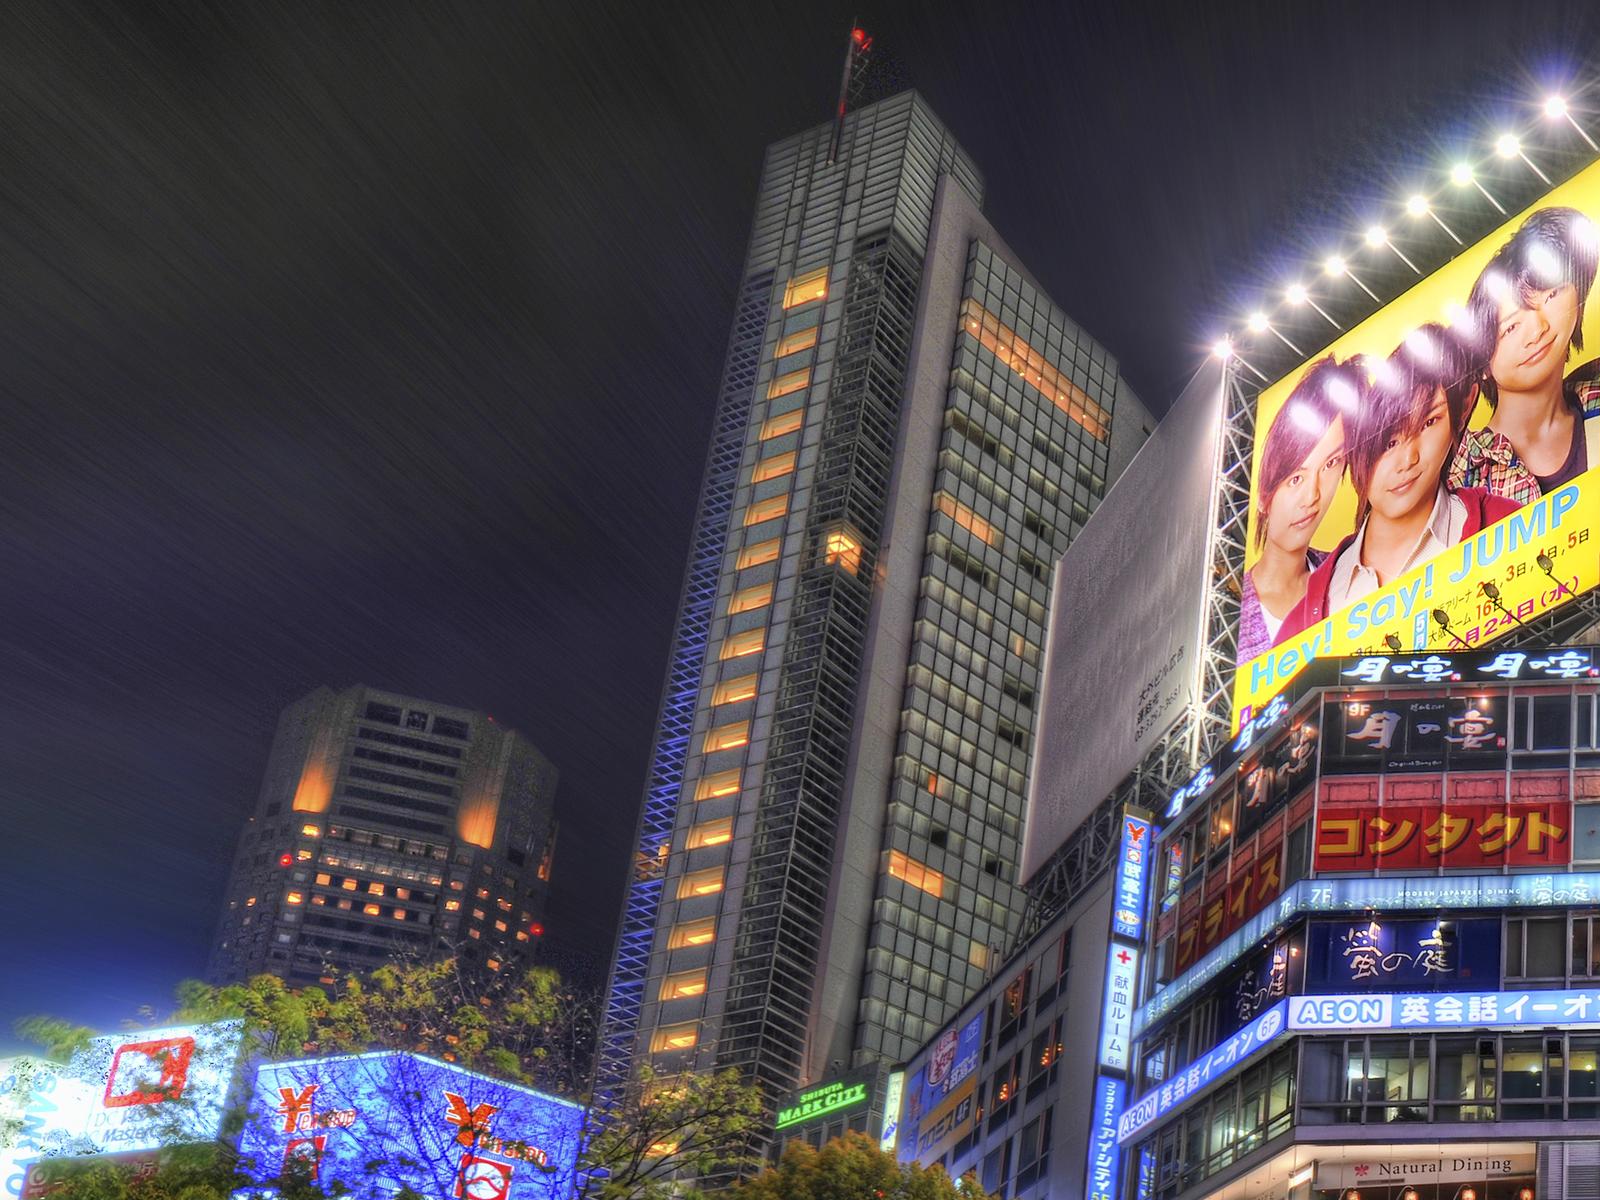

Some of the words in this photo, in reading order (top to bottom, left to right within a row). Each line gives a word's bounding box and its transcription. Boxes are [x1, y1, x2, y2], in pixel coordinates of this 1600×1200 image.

[1250, 621, 1332, 694] Hey!
[1347, 563, 1434, 639] Say!
[1449, 485, 1581, 583] JUMP
[1341, 655, 1454, 682] 月の宴
[1478, 651, 1592, 679] 月の宴
[1319, 811, 1565, 857] コンタクト
[1179, 853, 1280, 966] プライス
[1311, 888, 1333, 904] 7F
[1397, 889, 1435, 898] MODERN
[1439, 888, 1484, 897] JAPANESE
[1487, 887, 1521, 896] DINING
[1109, 975, 1129, 1053] 献血ルーム
[1299, 1000, 1381, 1024] AEON
[1107, 1055, 1121, 1066] 6F
[1119, 1099, 1156, 1138] AEON
[1160, 1031, 1253, 1112] 英会話イーオン
[1259, 1014, 1276, 1038] 6F
[778, 1097, 825, 1124] MARK
[825, 1082, 866, 1108] CITY
[800, 1082, 844, 1103] SHIBUYA
[1379, 1159, 1443, 1175] Natural
[1453, 1158, 1513, 1174] Dining
